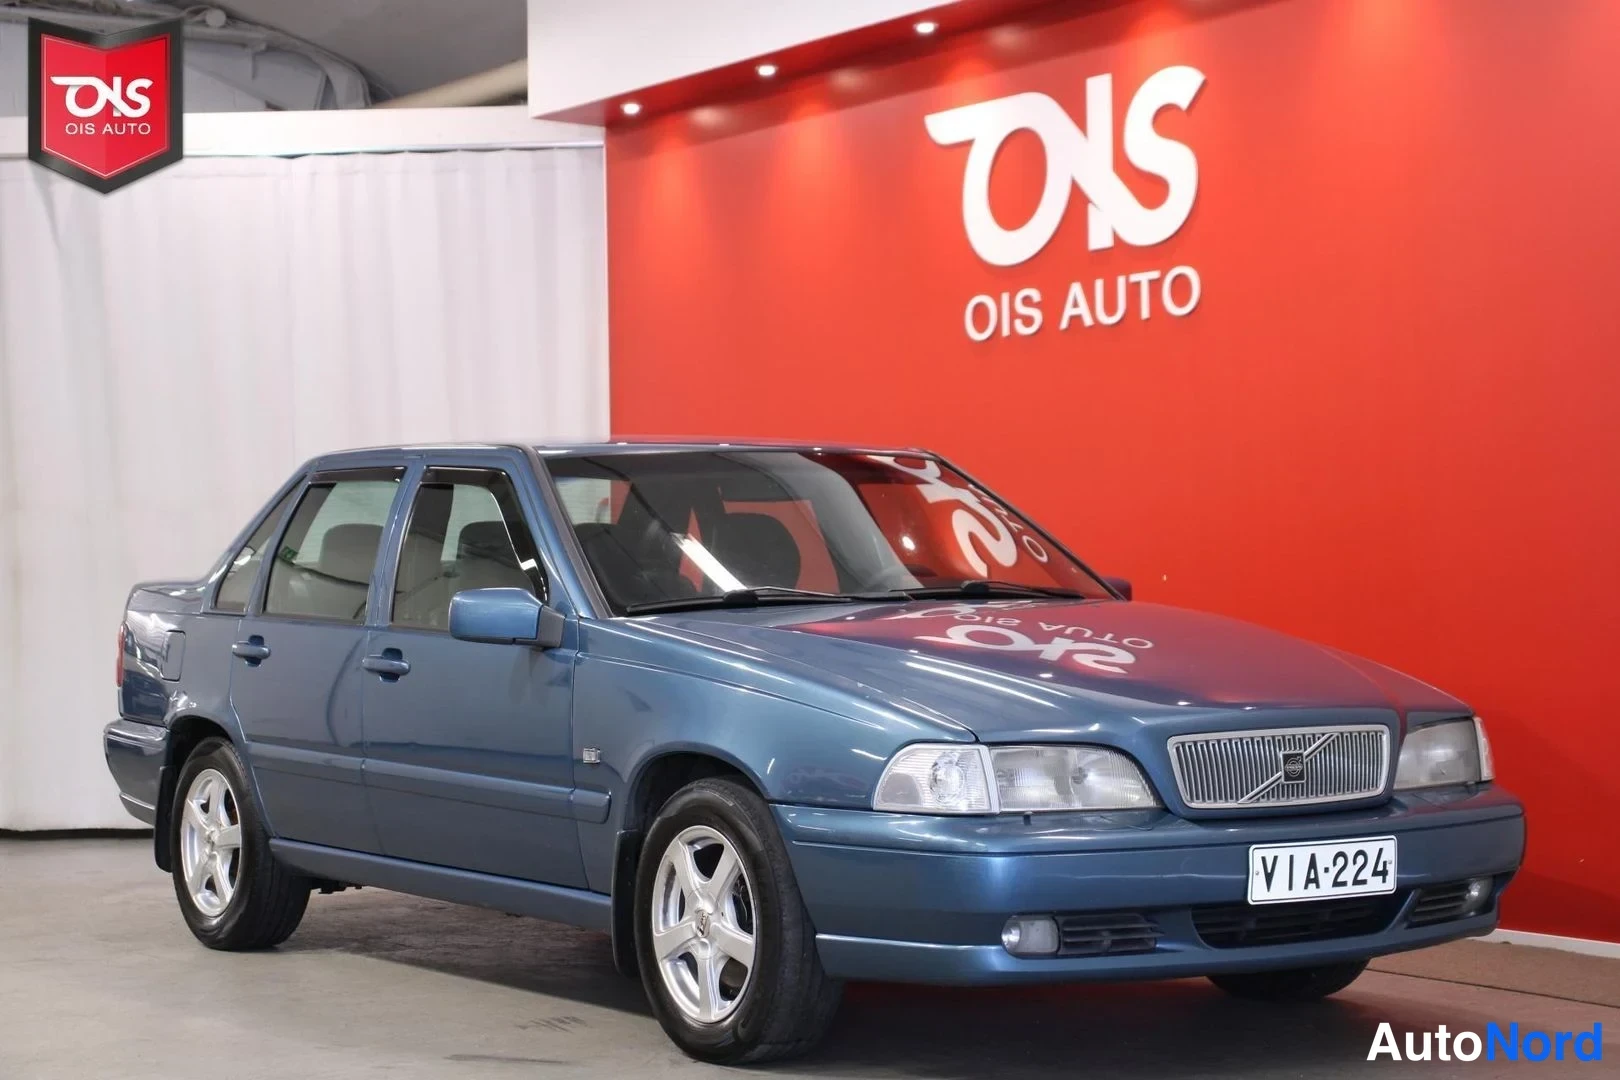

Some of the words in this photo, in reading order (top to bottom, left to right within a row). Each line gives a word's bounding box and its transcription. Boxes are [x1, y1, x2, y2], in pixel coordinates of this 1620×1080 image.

[924, 65, 1206, 267] OIS
[964, 288, 1043, 341] OIS
[1059, 265, 1201, 330] AUTO
[1261, 848, 1388, 893] VIA-224
